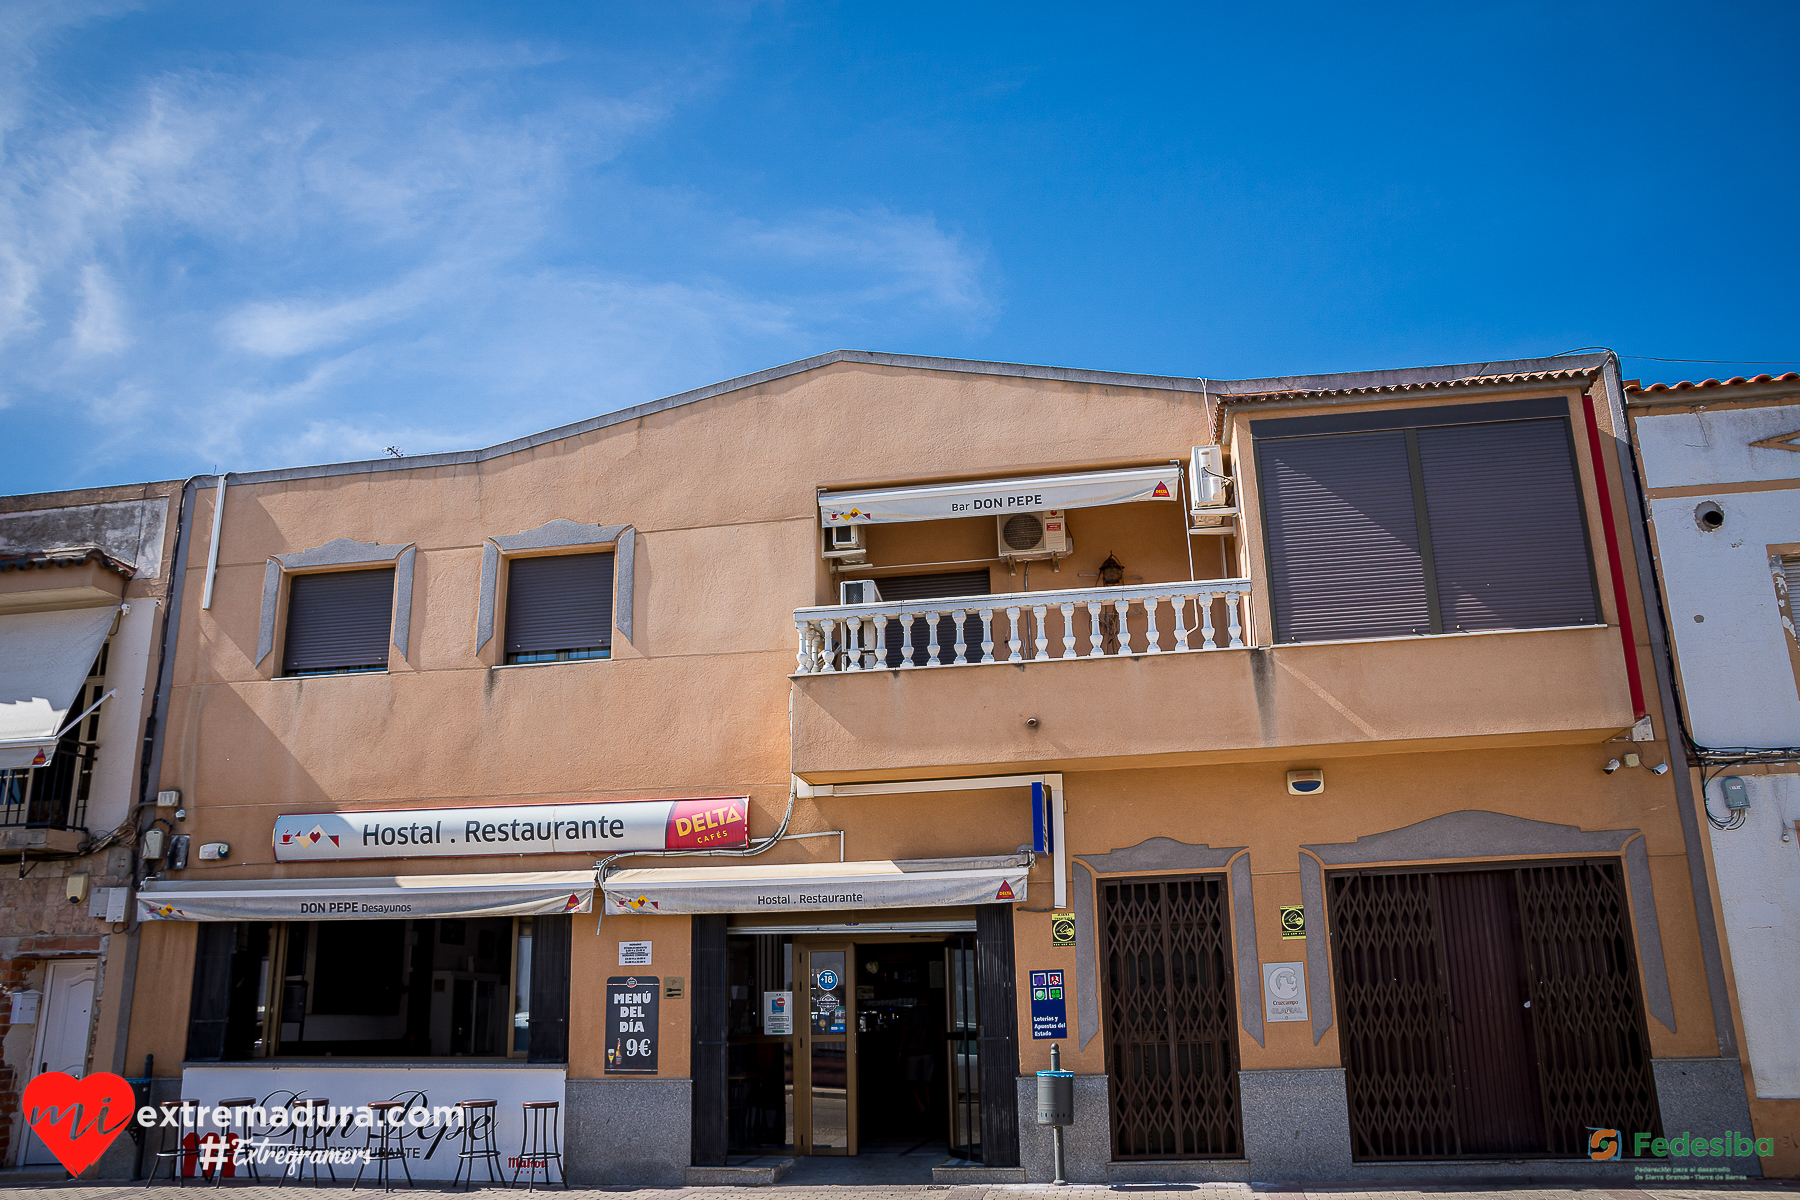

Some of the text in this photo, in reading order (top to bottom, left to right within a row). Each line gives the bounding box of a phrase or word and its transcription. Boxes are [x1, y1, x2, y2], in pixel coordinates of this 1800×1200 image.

[951, 494, 1042, 512] Bar DON PEPE
[675, 805, 742, 837] DELTA
[362, 815, 624, 847] Hostal Restaurante
[696, 829, 729, 845] CAFÉS
[757, 892, 863, 905] Hostal Restaurante
[300, 901, 412, 914] DON PEPE Desayunos
[820, 975, 834, 984] +18
[613, 990, 652, 1004] MENÚ
[620, 1006, 645, 1018] DEL
[619, 1018, 645, 1033] DÍA
[626, 1038, 652, 1057] 9€
